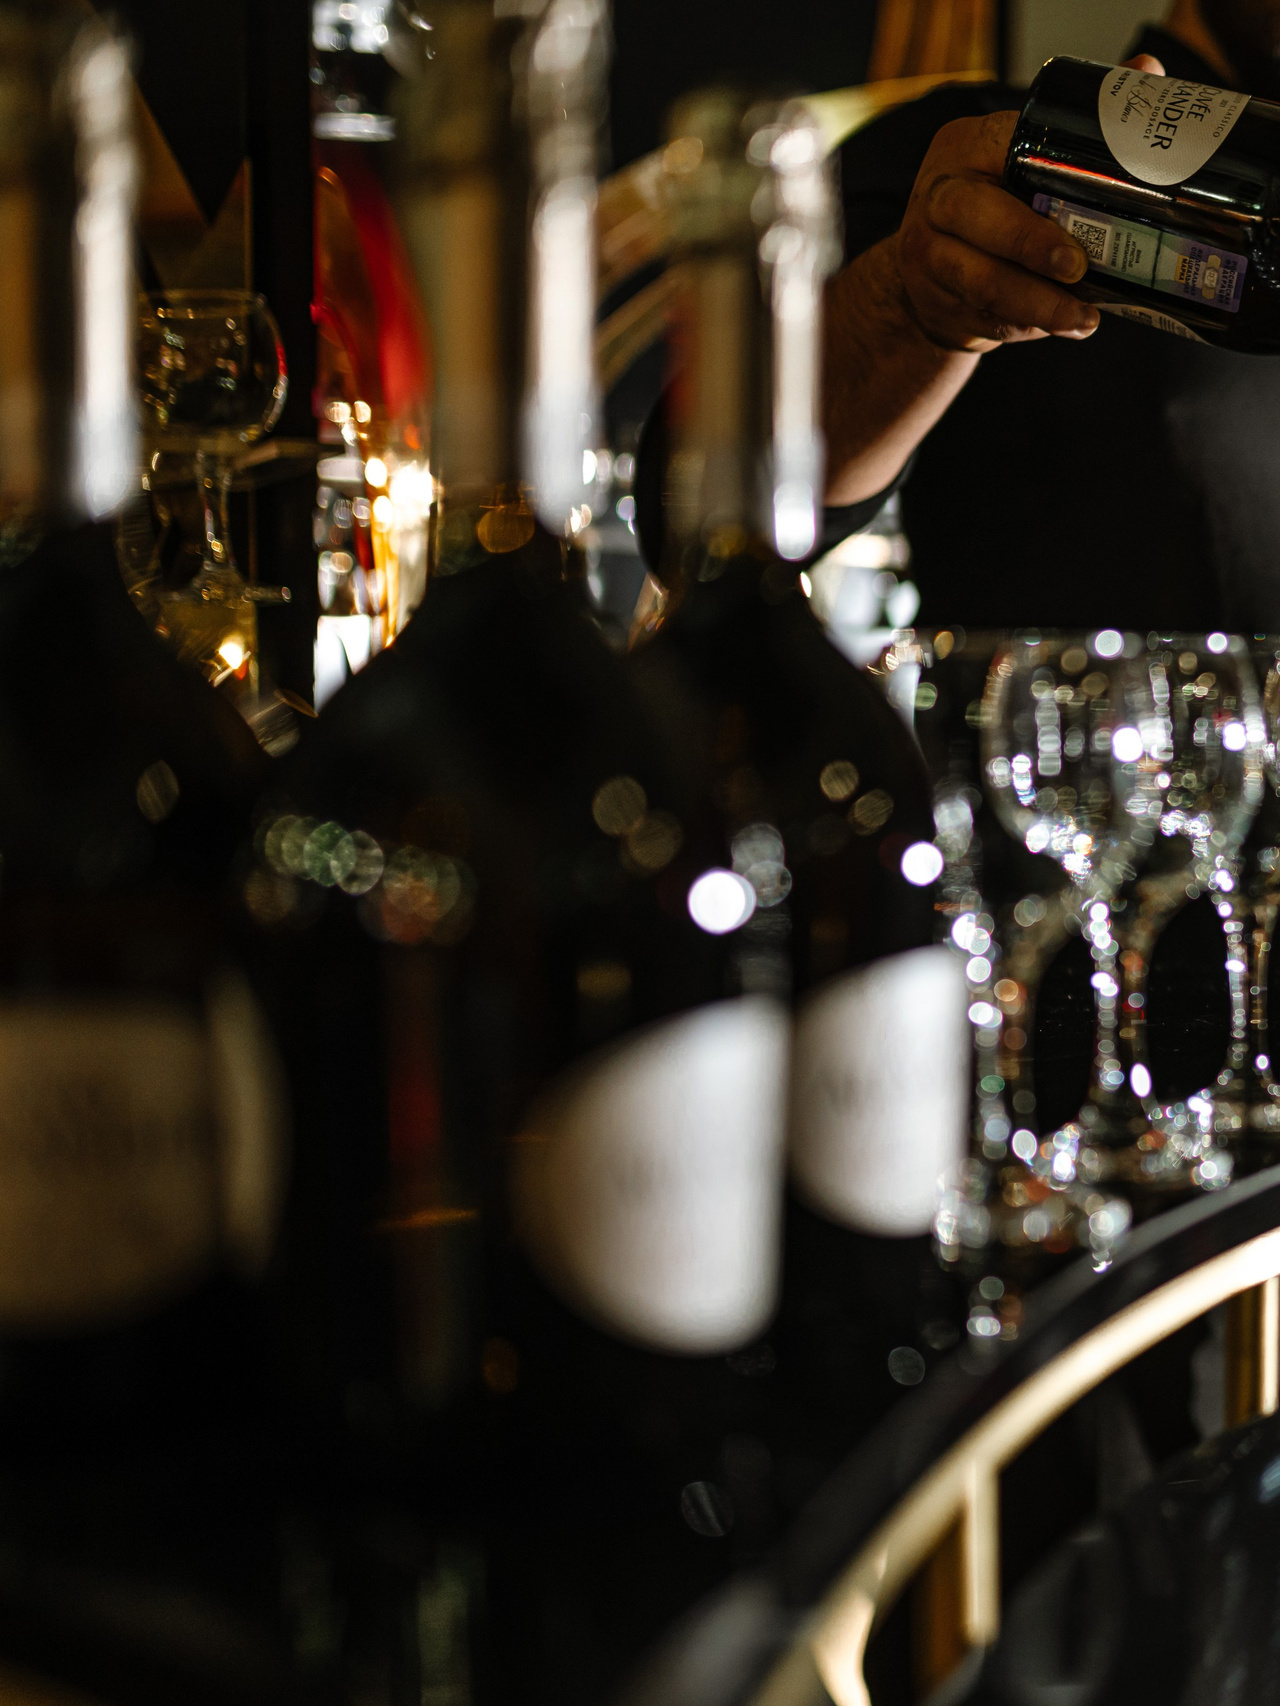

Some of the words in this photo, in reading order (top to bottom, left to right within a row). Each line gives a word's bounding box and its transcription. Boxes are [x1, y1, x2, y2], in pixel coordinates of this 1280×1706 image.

[1185, 86, 1222, 122] CUVÉE
[1212, 104, 1238, 138] CLASSICO
[1142, 106, 1161, 140] DOSAGE
[1178, 258, 1188, 280] МАРКА
